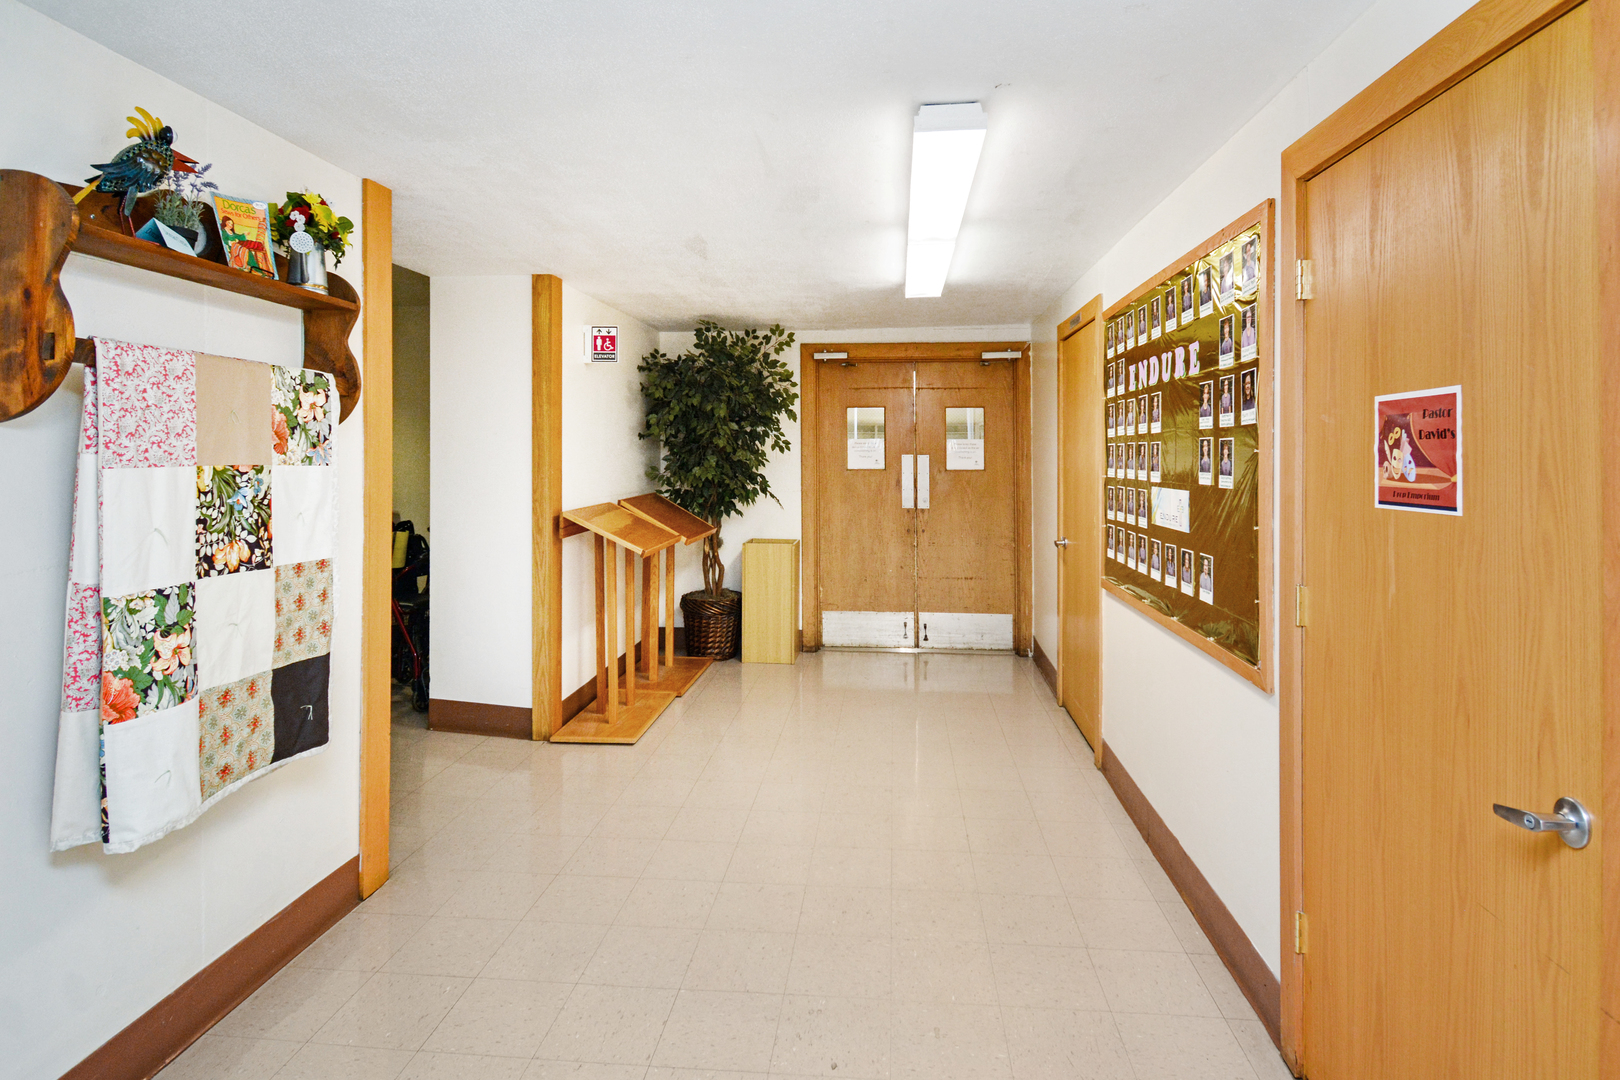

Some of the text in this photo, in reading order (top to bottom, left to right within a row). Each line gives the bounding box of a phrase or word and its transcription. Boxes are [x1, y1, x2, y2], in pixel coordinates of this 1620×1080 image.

[222, 199, 256, 214] Dorcas
[243, 213, 261, 221] Others
[1128, 340, 1200, 392] ENDURE
[1422, 407, 1453, 419] Pastor
[1419, 428, 1456, 440] David's
